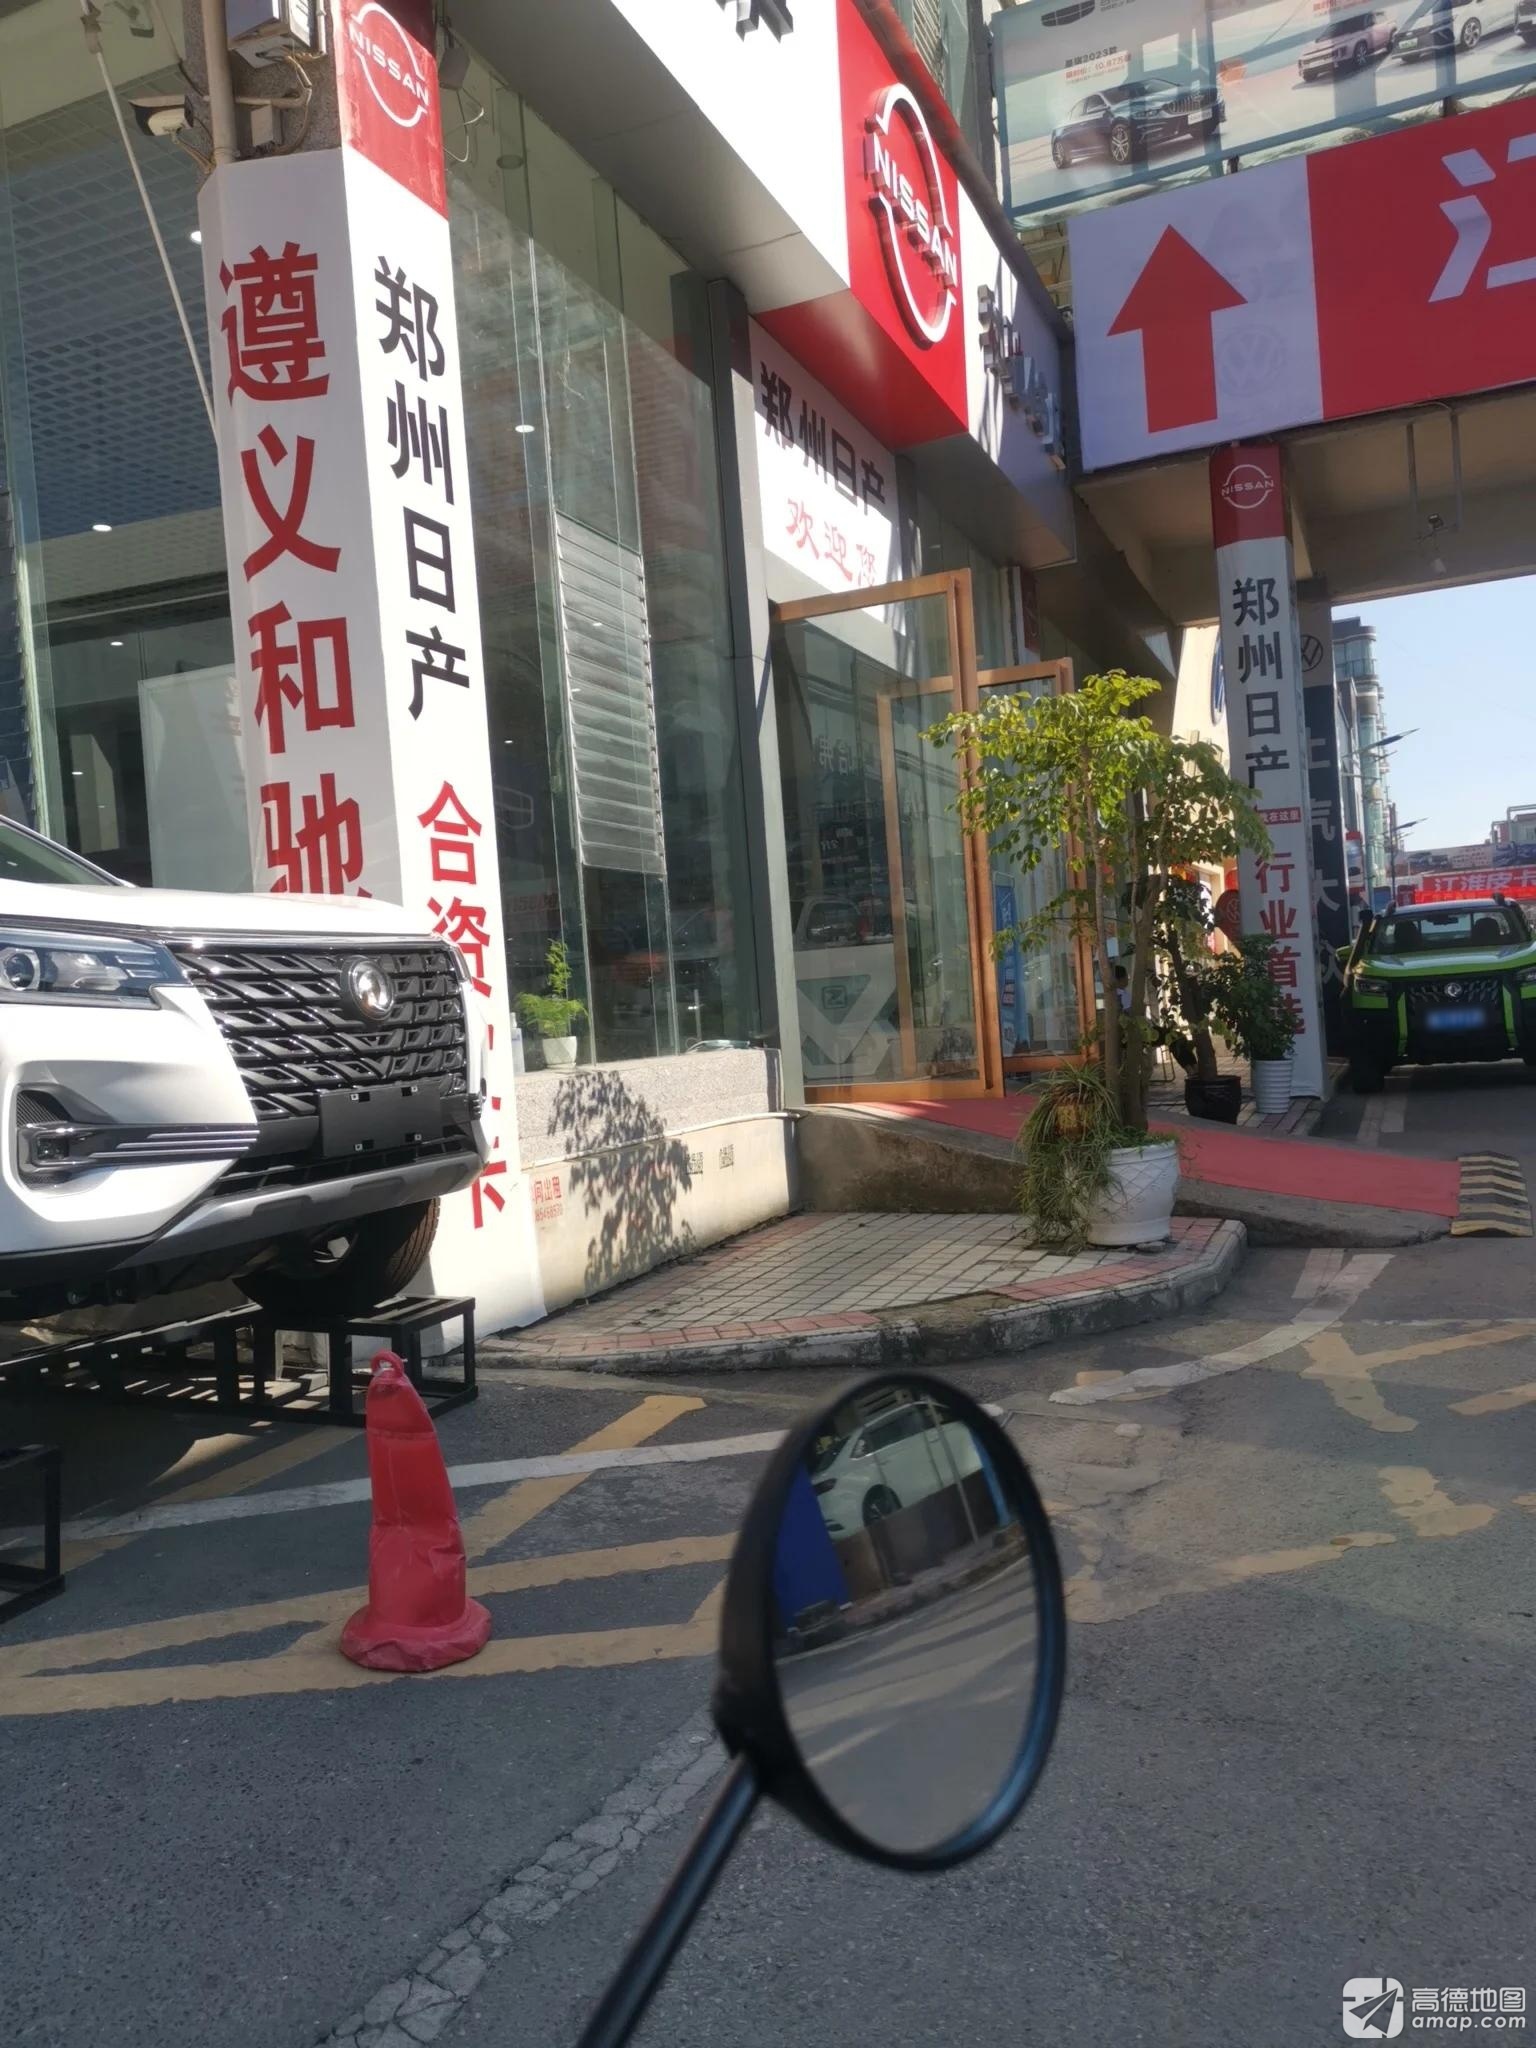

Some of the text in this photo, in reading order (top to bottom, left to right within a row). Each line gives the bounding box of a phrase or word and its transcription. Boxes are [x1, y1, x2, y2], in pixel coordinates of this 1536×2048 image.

[349, 27, 430, 102] NISSAN
[872, 147, 958, 289] NISSAN
[374, 255, 470, 721] 郑州日产
[760, 361, 886, 516] 郑州日产
[1220, 478, 1275, 497] NISSAN
[1232, 576, 1290, 790] 郑州日产
